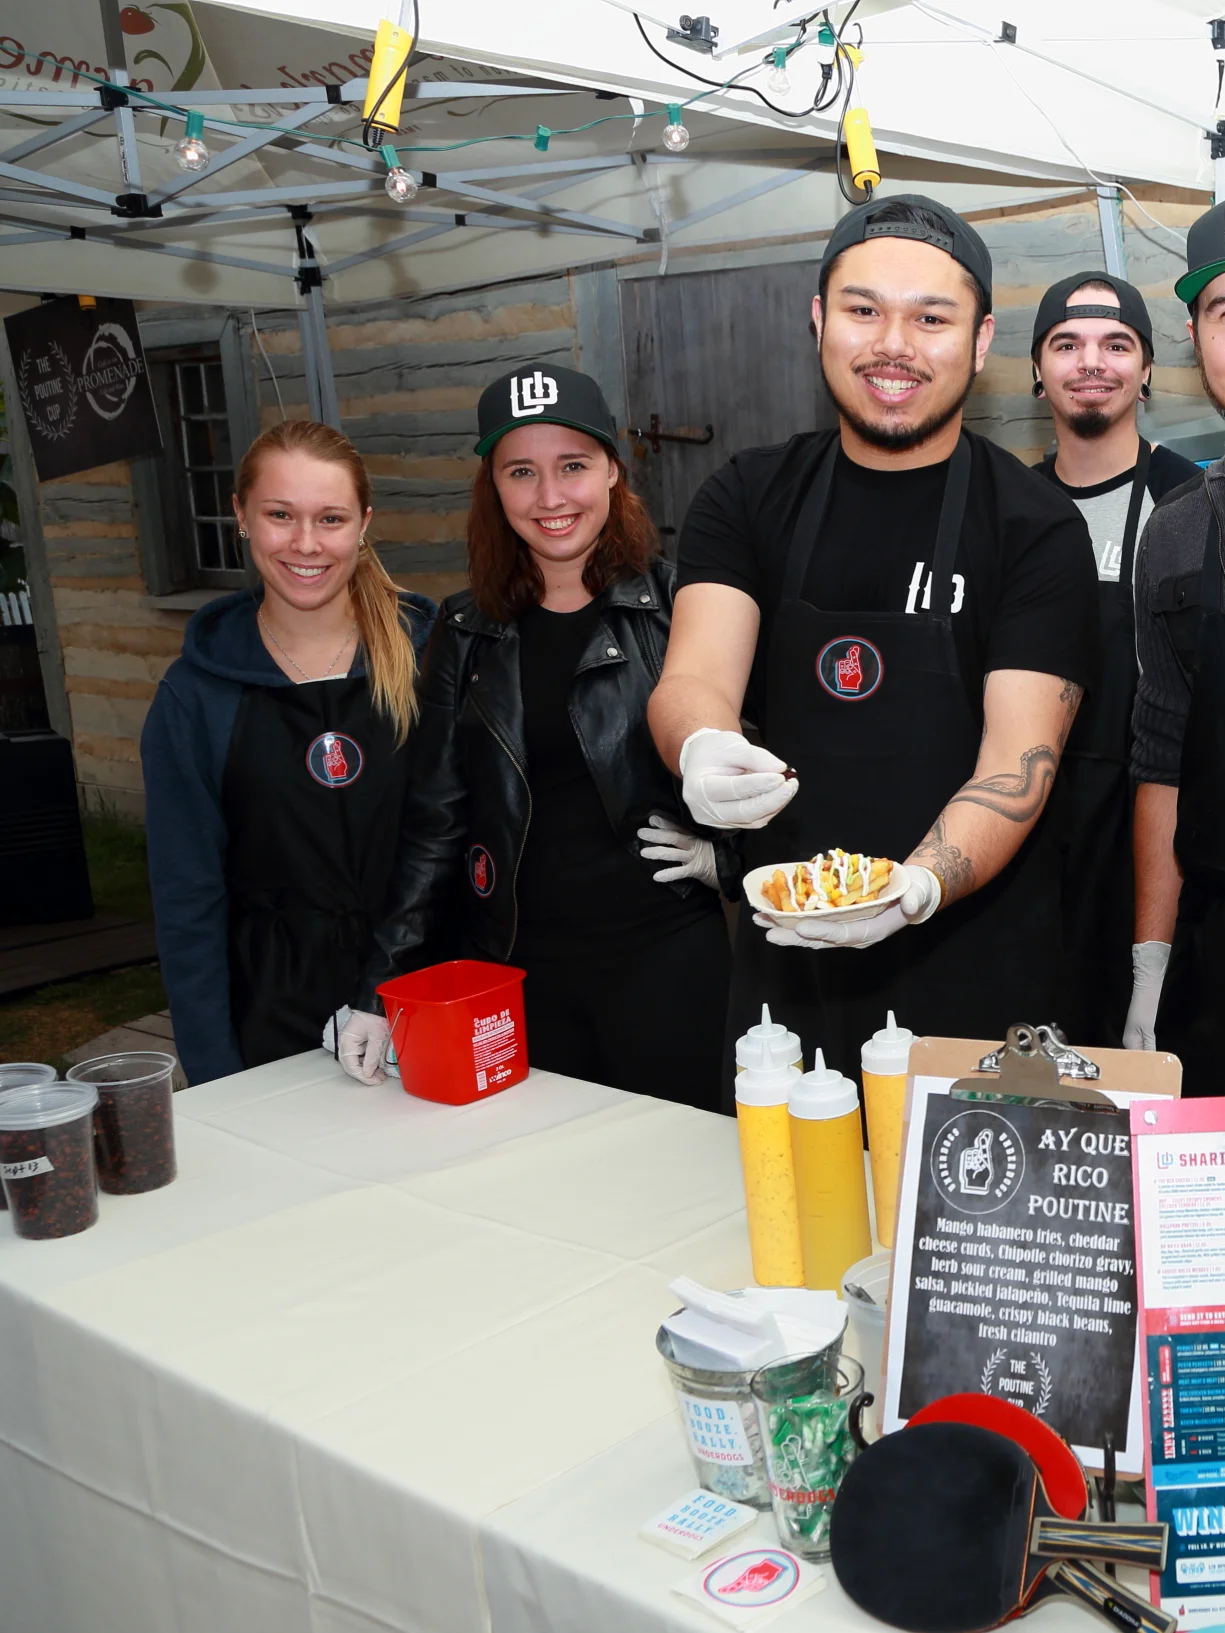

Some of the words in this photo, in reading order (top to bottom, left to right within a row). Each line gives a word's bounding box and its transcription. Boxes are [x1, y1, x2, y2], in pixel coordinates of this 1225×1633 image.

[36, 356, 51, 374] THE
[76, 358, 145, 393] PROMENADE
[34, 377, 64, 400] POUTINE
[46, 404, 61, 422] CUP
[474, 1014, 498, 1028] CUBO
[500, 1008, 510, 1018] DE
[474, 1015, 512, 1036] LIMPIEZA
[1038, 1128, 1078, 1151] AY
[1081, 1132, 1130, 1157] QUE
[939, 1127, 960, 1193] UNDERDOGS
[995, 1132, 1016, 1197] UNDERDOGS
[1053, 1164, 1109, 1188] RICO
[1028, 1195, 1129, 1225] POUTINE
[936, 1217, 974, 1236] Mango
[976, 1221, 1033, 1242] habanero
[1035, 1227, 1065, 1247] fries,
[1068, 1232, 1120, 1251] cheddar
[918, 1235, 957, 1253] cheese
[960, 1241, 995, 1259] curds,
[997, 1243, 1046, 1263] Chipotle
[1048, 1250, 1092, 1269] chorizo
[1095, 1255, 1133, 1275] gravy,
[931, 1256, 958, 1273] herb
[960, 1261, 986, 1277] sour
[988, 1264, 1029, 1284] cream,
[1032, 1268, 1072, 1287] grilled
[1074, 1275, 1118, 1293] mango
[915, 1275, 947, 1293] salsa,
[950, 1279, 993, 1298] pickled
[995, 1283, 1052, 1307] jalapeño,
[1055, 1290, 1100, 1311] Tequila
[1103, 1296, 1130, 1314] lime
[928, 1296, 995, 1320] guacamole,
[998, 1305, 1034, 1325] crispy
[1036, 1308, 1069, 1328] black
[1072, 1313, 1112, 1334] beans,
[978, 1322, 1007, 1340] fresh
[1010, 1326, 1057, 1346] cilantro
[1010, 1359, 1026, 1375] THE
[998, 1377, 1035, 1395] POUTINE
[690, 1419, 738, 1436] BOOZE.
[697, 1448, 745, 1461] UNDERDOGS
[680, 1504, 726, 1528] BOOZE.
[693, 1495, 737, 1519] FOOD.
[657, 1522, 705, 1542] UNDERDOGS
[667, 1513, 713, 1535] RALLY.
[1187, 1542, 1199, 1550] FULL
